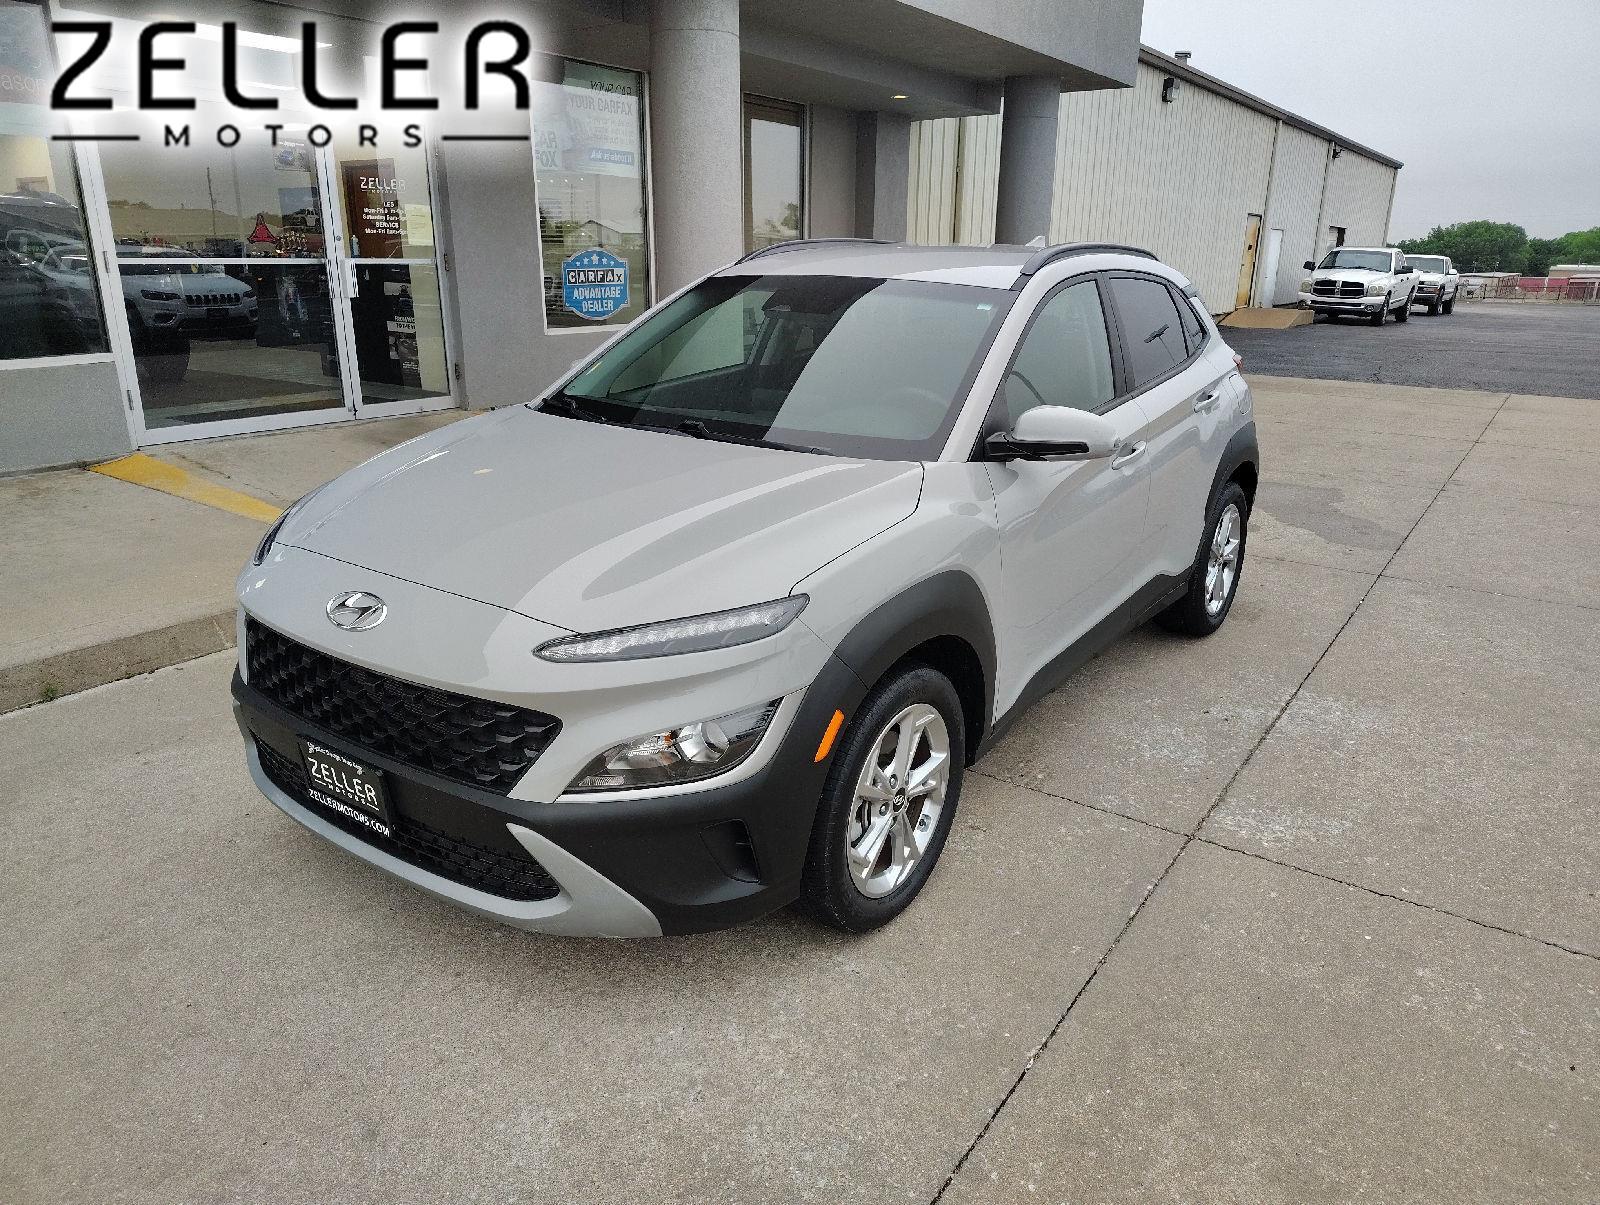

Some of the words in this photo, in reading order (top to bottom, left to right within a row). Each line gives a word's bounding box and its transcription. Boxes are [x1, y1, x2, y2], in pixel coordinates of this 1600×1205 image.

[597, 97, 633, 116] CARFAX
[360, 177, 405, 192] ZELLER
[568, 270, 623, 283] CARFAX
[573, 286, 621, 300] ADVANTAGE
[582, 299, 614, 312] DEALER
[307, 757, 377, 805] ZELLER
[308, 788, 390, 837] ZELLERMOTORS.COM
